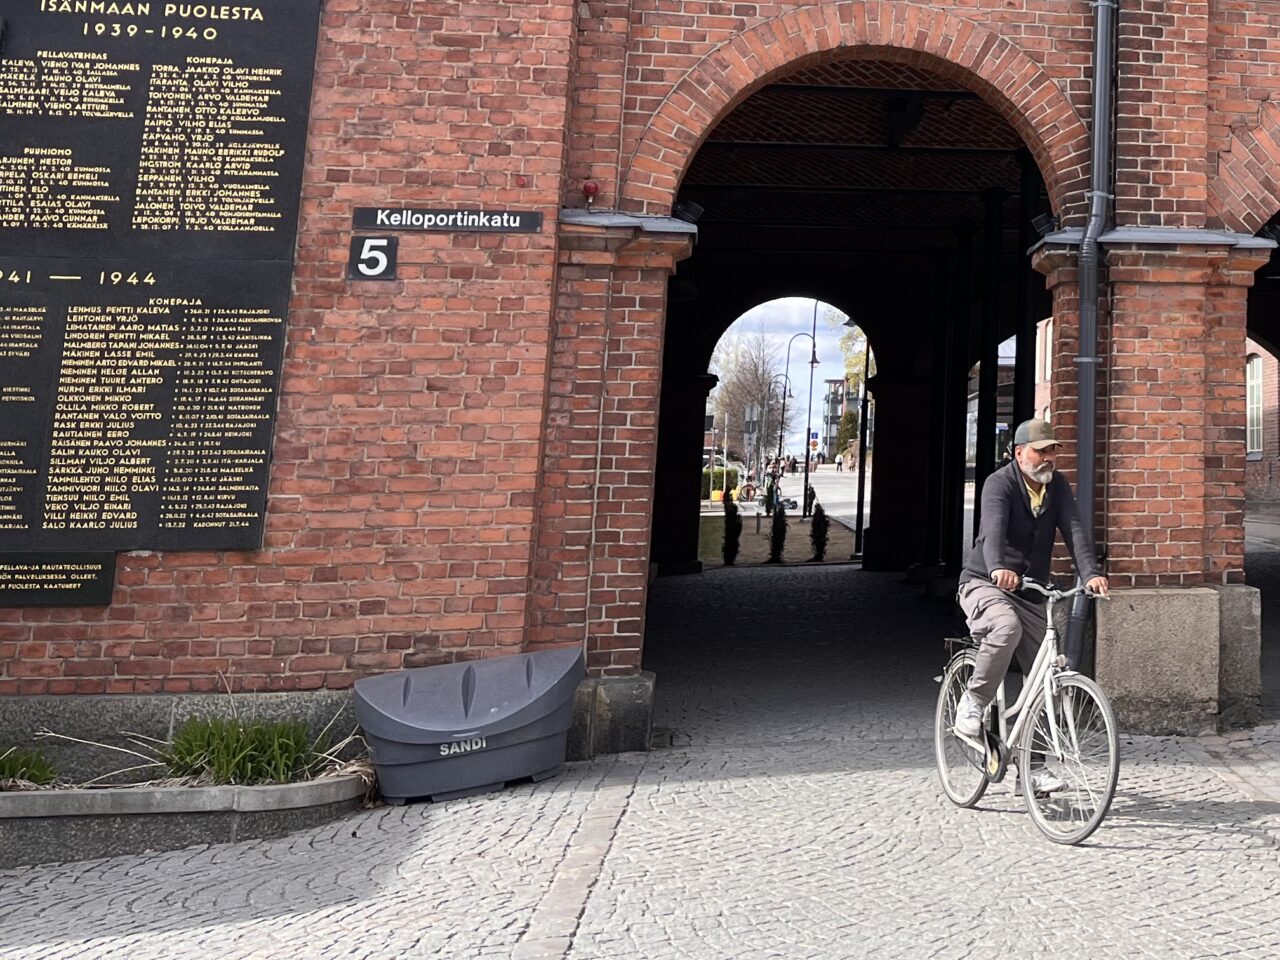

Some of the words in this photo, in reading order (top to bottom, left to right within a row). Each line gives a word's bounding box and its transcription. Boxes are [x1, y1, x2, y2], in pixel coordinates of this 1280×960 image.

[164, 3, 264, 21] PUOLESTA
[37, 51, 107, 60] PELLAVATEHDAS
[186, 56, 233, 64] KONEPAJA
[185, 66, 220, 74] JAAKKO
[226, 94, 269, 102] VALDEMAR
[24, 148, 72, 156] PUUHIOMO
[376, 210, 521, 229] Kelloportinkatu
[358, 239, 388, 276] 5
[100, 271, 156, 285] 1944
[116, 314, 138, 322] YRJÖ
